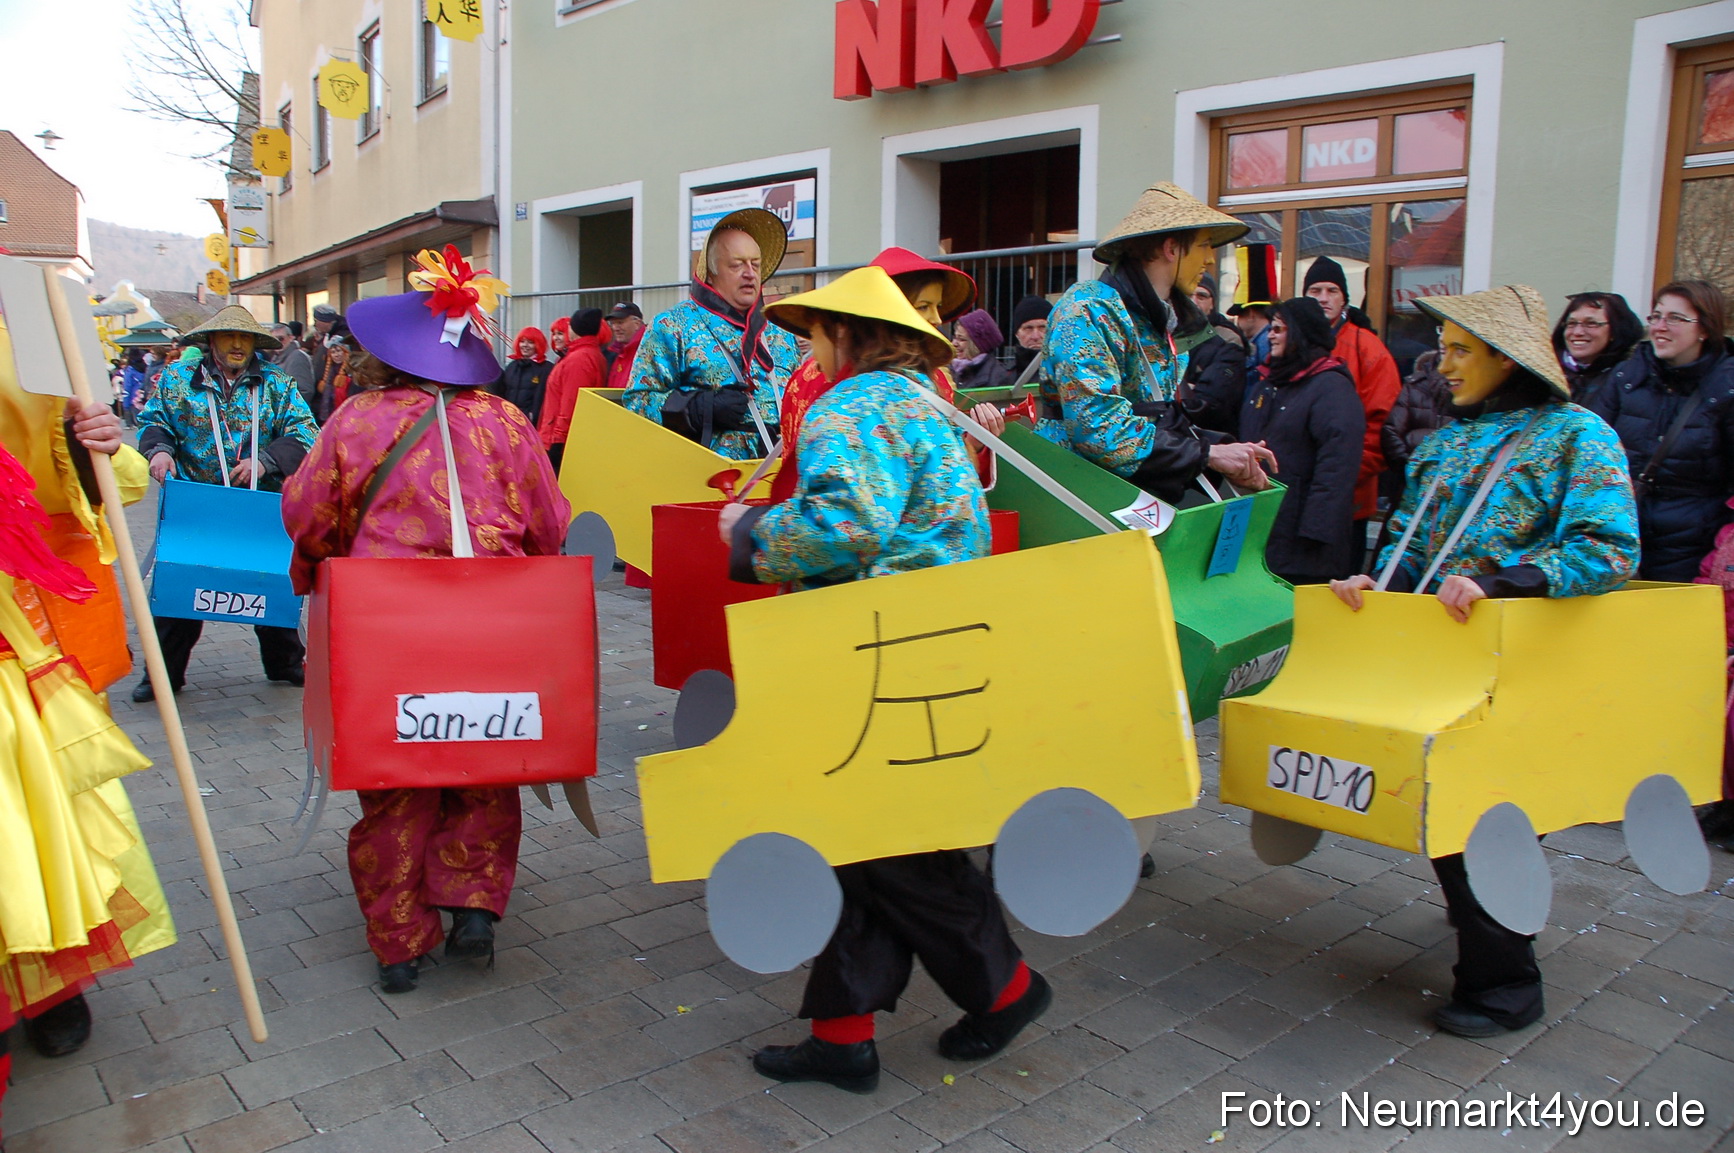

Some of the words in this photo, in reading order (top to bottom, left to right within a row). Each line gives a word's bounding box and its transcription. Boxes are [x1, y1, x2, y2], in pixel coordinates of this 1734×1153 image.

[834, 0, 1099, 101] NKD
[1306, 137, 1377, 169] NKD
[195, 589, 265, 617] SPD-4
[396, 694, 533, 740] San-di
[1271, 747, 1376, 813] SPD-10
